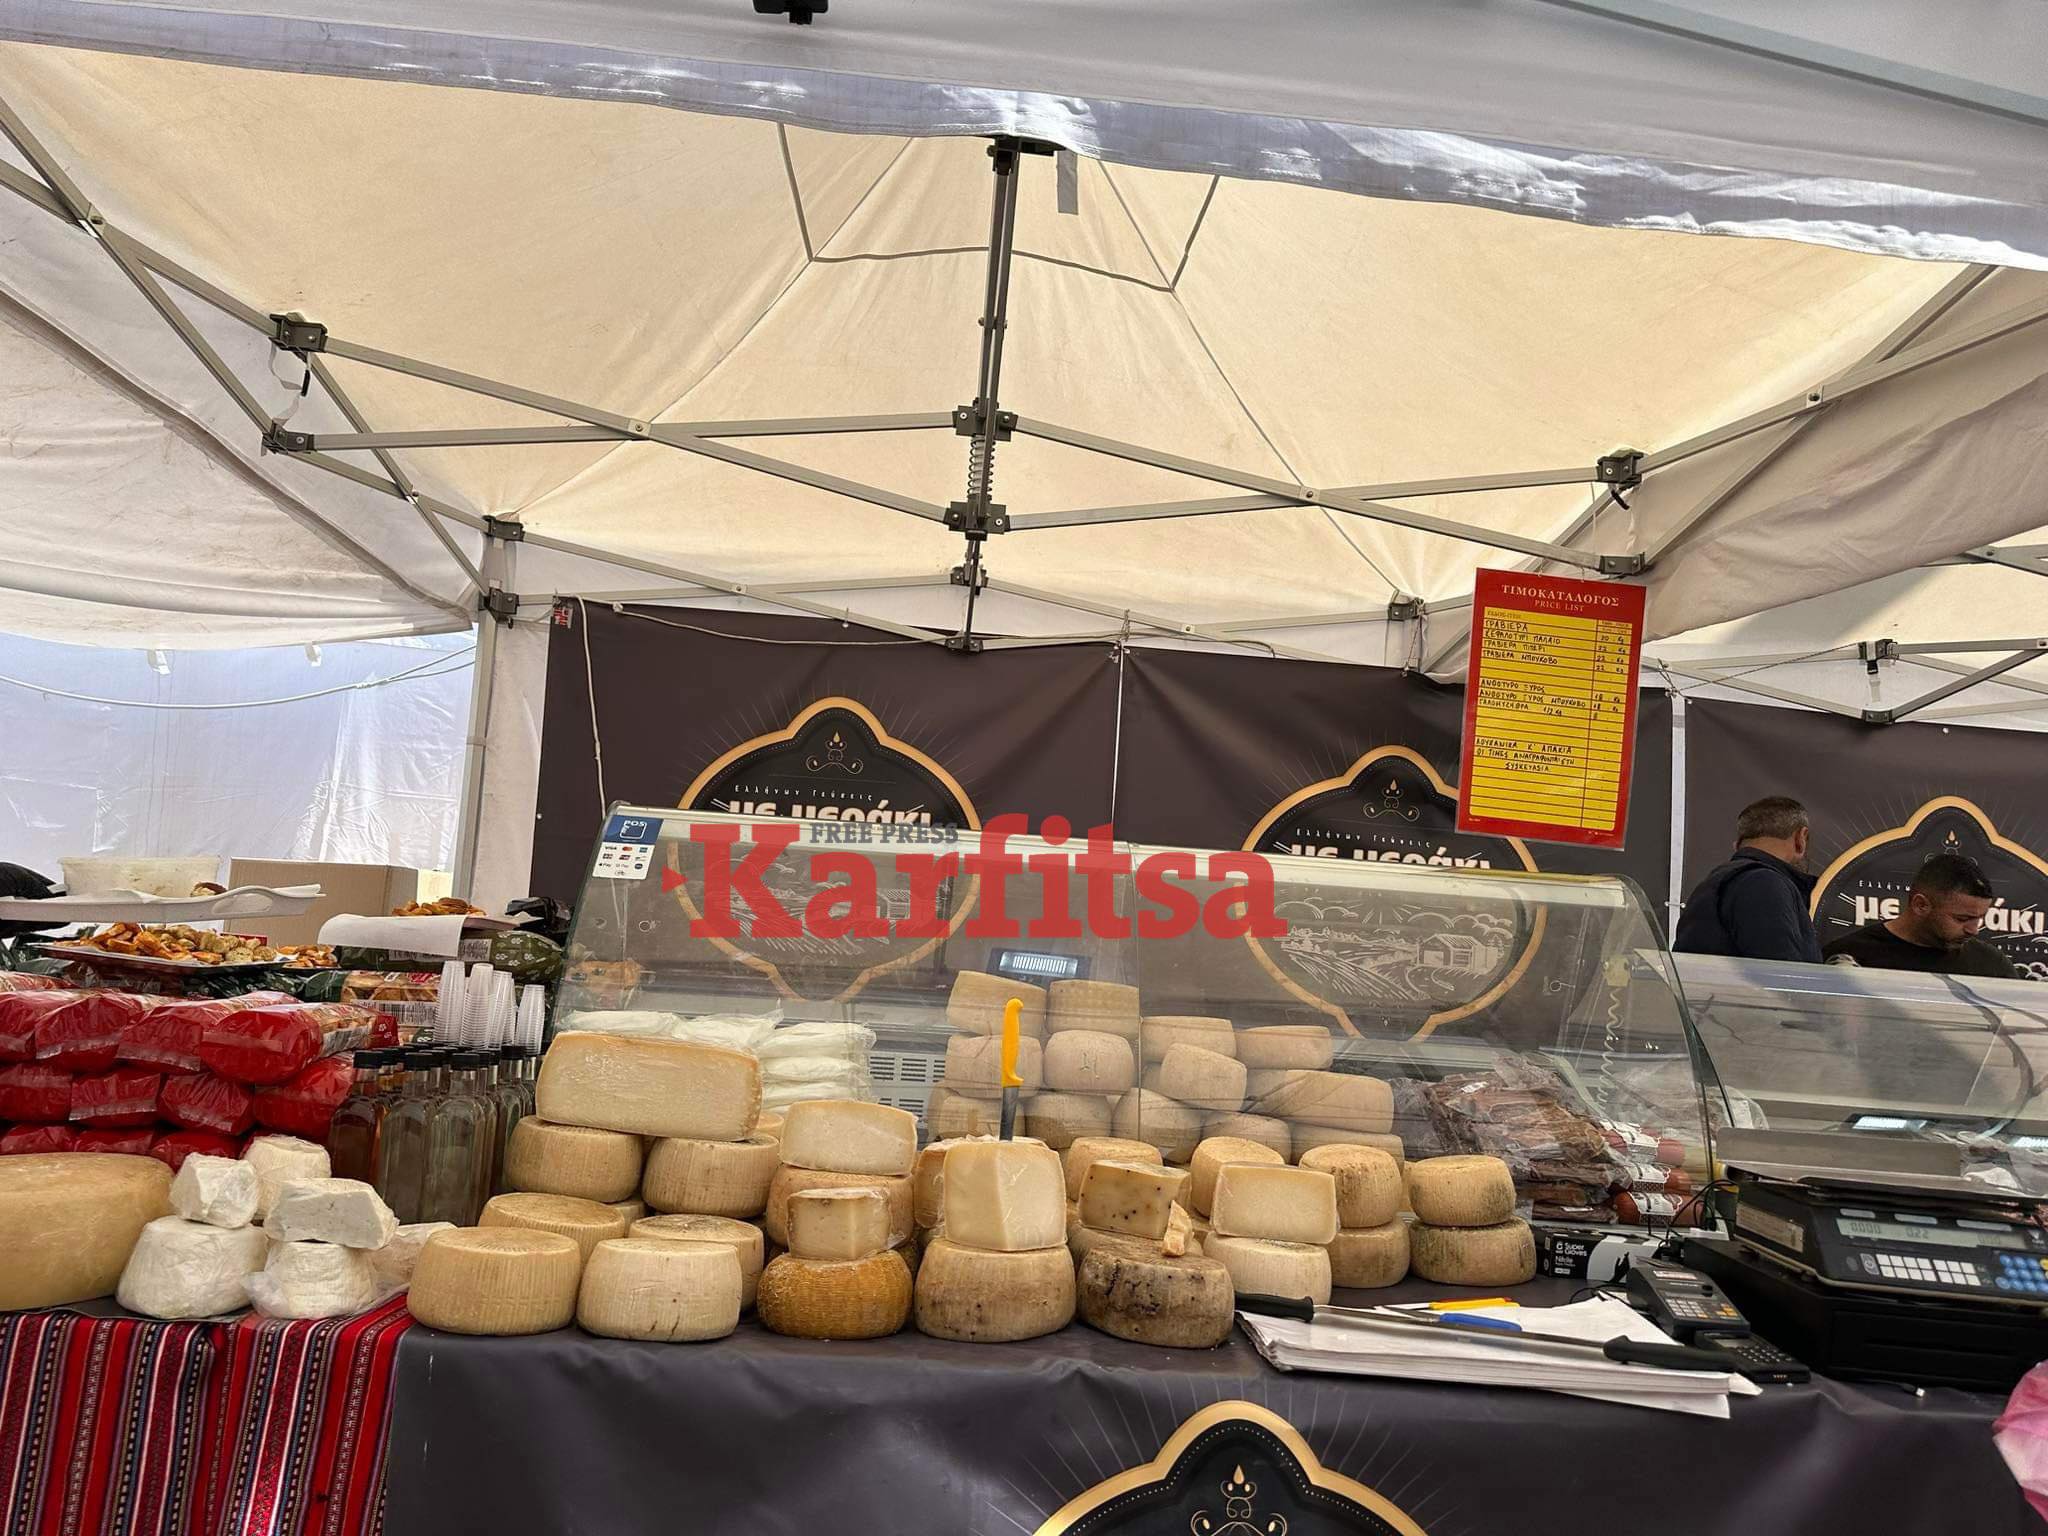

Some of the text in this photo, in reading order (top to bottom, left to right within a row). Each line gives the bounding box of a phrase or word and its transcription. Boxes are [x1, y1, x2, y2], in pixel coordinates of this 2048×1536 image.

[1502, 584, 1619, 607] ΤΙΜΟΚΑΤΑΛΟΓΟΣ
[1535, 600, 1585, 612] PRICE LIST
[1484, 620, 1528, 633] ΓΡΑΒΙΕΡΑ
[1484, 639, 1517, 650] ΓΡΑΒΙΕΡΑ
[1483, 649, 1515, 660] ΓΡΑΒΙΕΡΑ
[1481, 679, 1519, 689] ΑΝΘΟΤΥΡΟ
[735, 784, 800, 796] Ελλήνων
[1855, 895, 1900, 926] με
[1564, 1242, 1585, 1251] Super
[1564, 1249, 1588, 1257] Gloves
